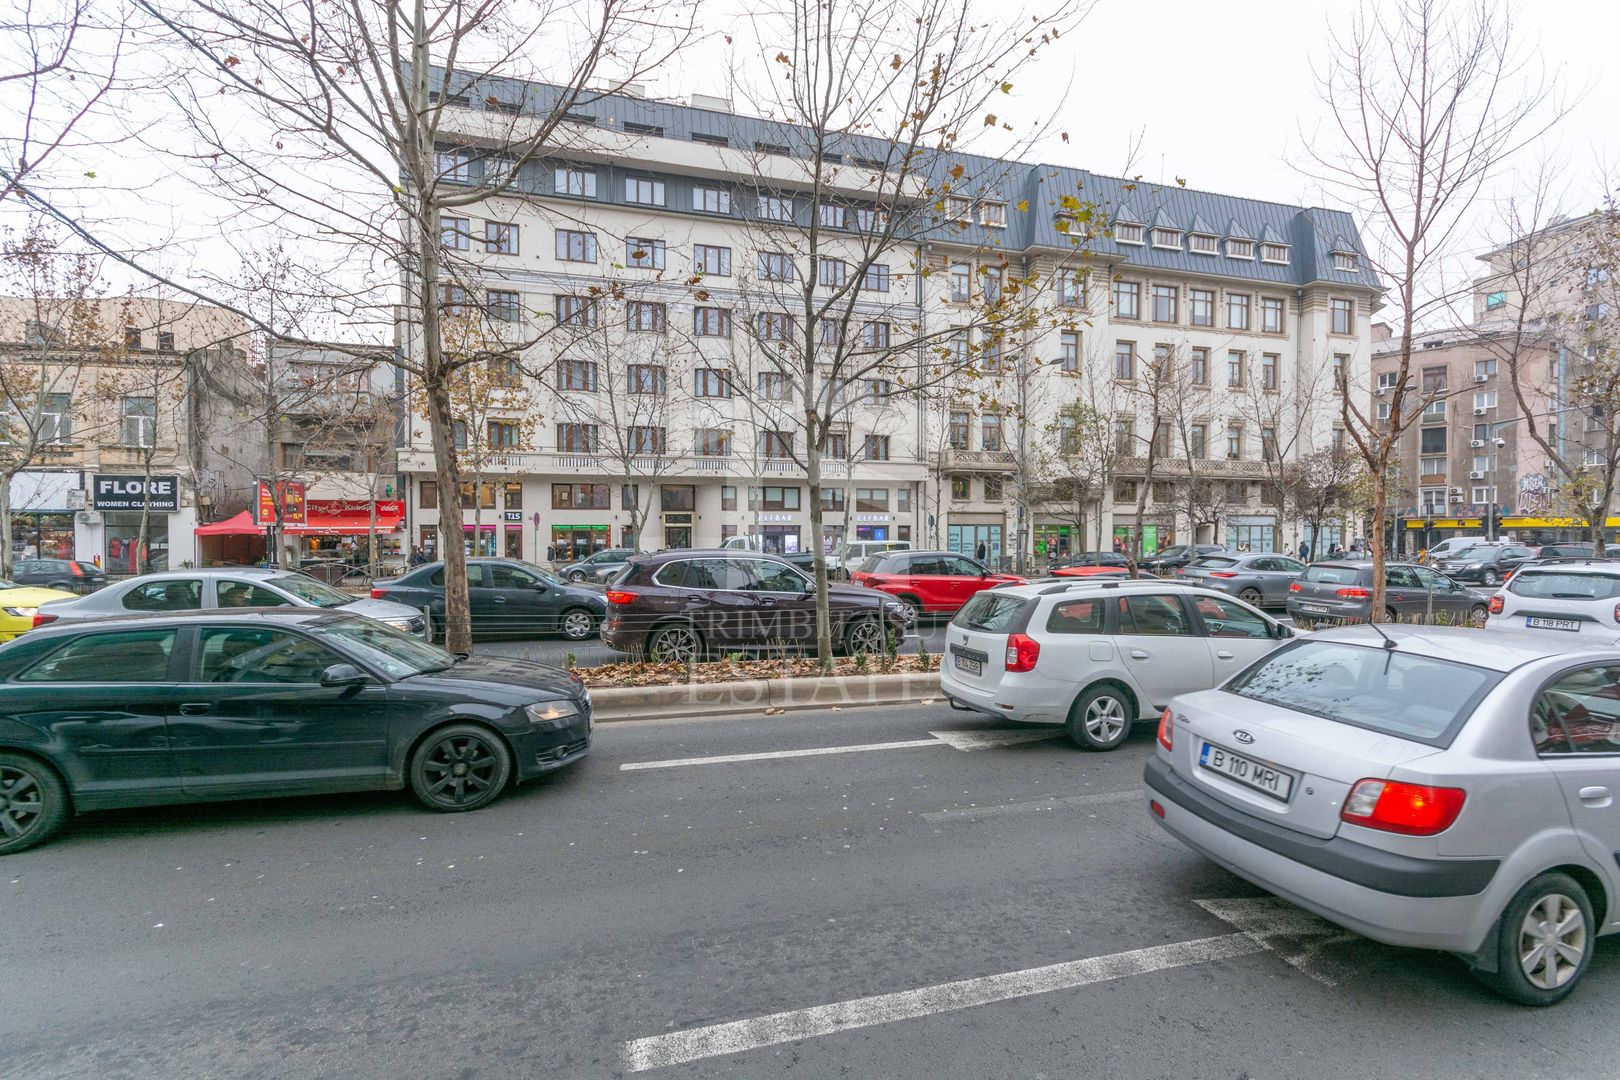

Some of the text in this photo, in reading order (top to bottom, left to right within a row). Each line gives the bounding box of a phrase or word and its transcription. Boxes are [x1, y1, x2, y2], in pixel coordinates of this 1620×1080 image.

[100, 481, 171, 494] FLORE
[1213, 751, 1280, 791] B 110 MRI
